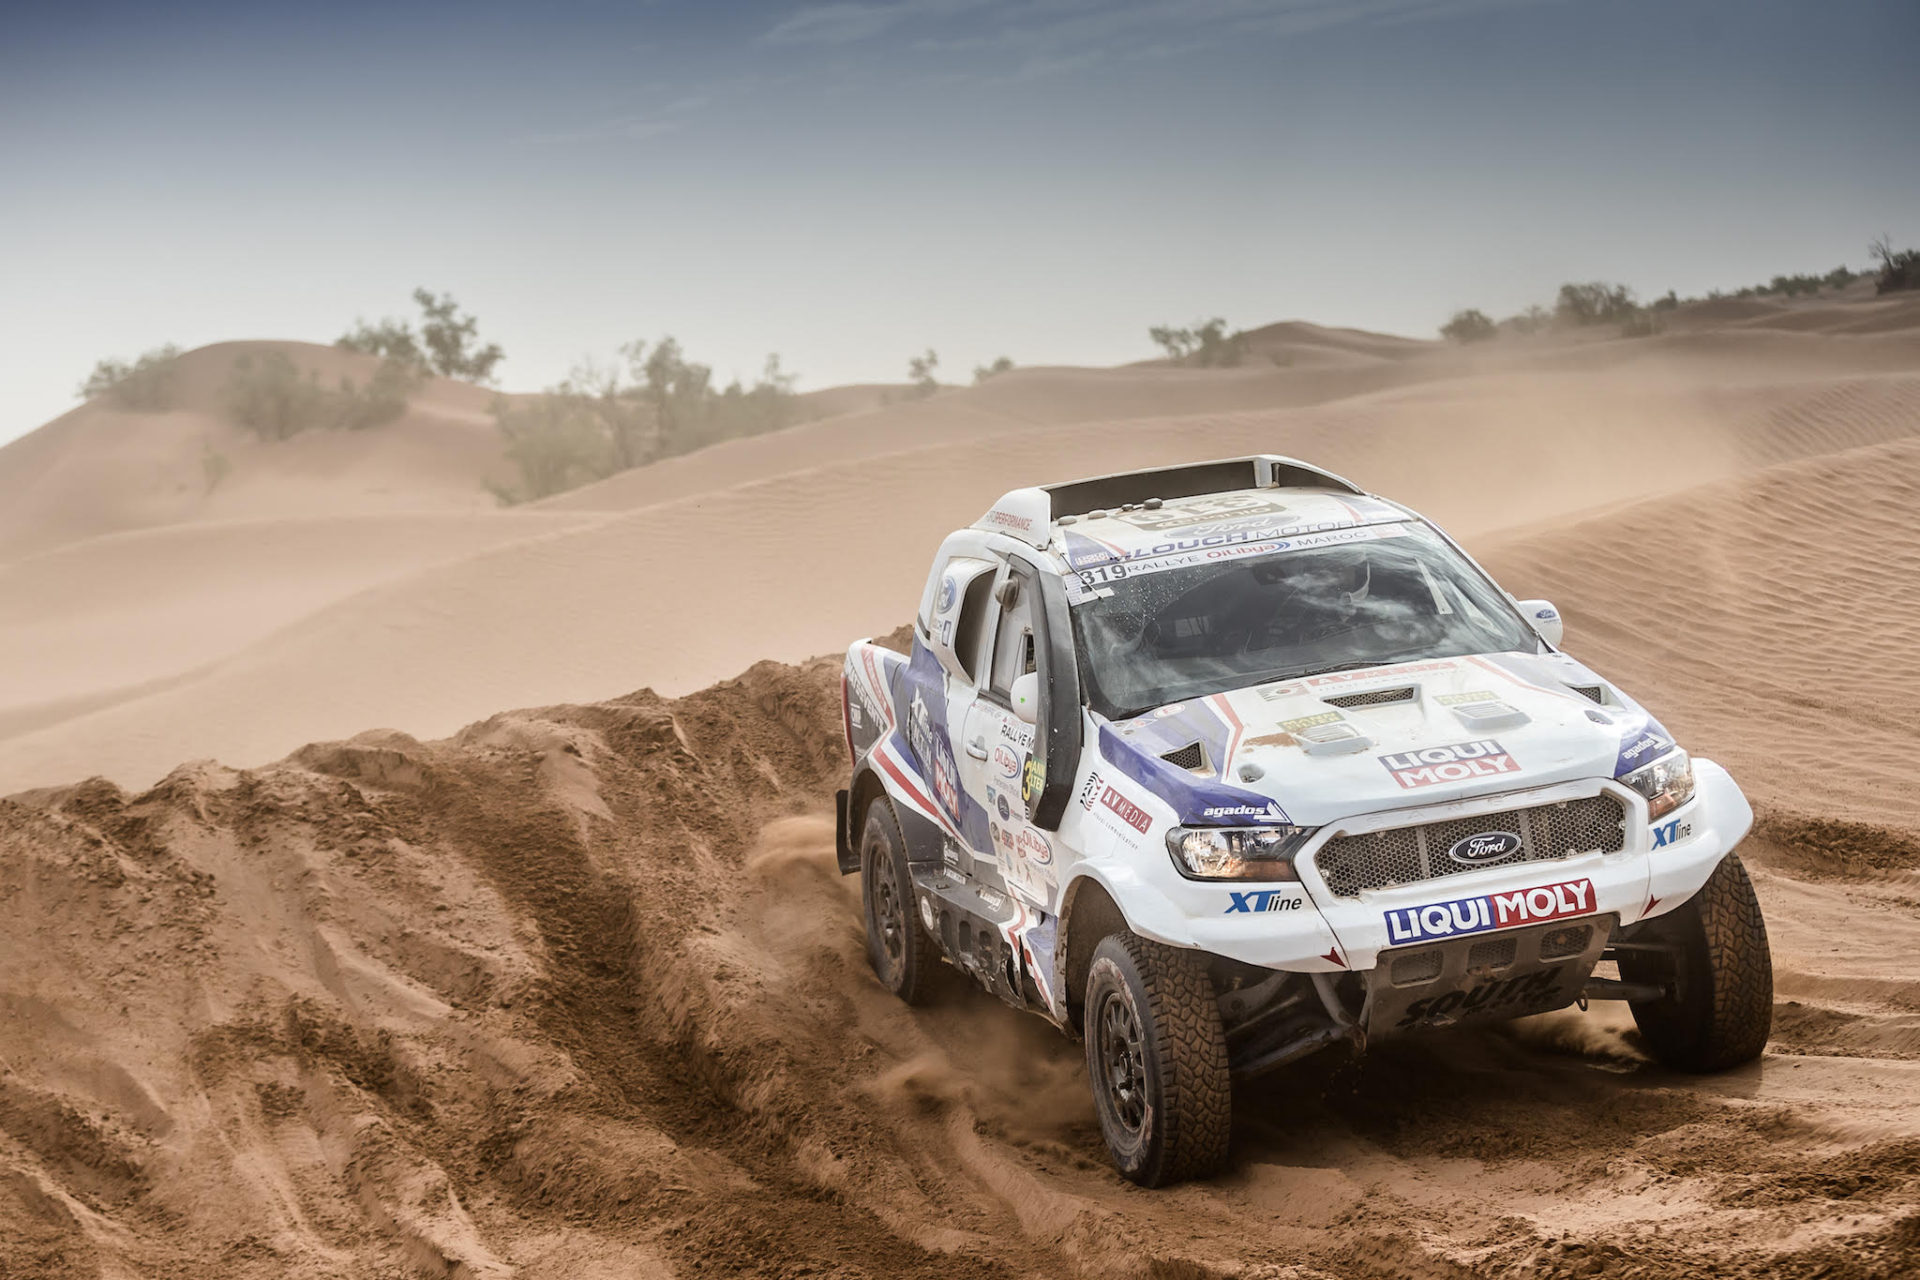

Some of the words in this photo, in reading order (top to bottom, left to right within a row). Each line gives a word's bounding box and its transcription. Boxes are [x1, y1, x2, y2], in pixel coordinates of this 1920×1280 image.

[1080, 564, 1127, 585] 319
[1127, 555, 1200, 573] RALLYE
[1206, 542, 1276, 560] OiLibya
[1297, 531, 1367, 547] MAROC
[1126, 530, 1247, 560] LOUCH
[1000, 724, 1028, 747] RALLYE
[1622, 737, 1656, 760] agados
[1383, 740, 1506, 770] LIQUI
[1397, 756, 1514, 788] MOLY
[1203, 804, 1265, 818] agados
[1467, 836, 1507, 857] Ford
[1651, 818, 1692, 852] XTline
[1224, 890, 1302, 914] XTline
[1388, 898, 1491, 941] LIQUI
[1493, 880, 1589, 924] MOLY
